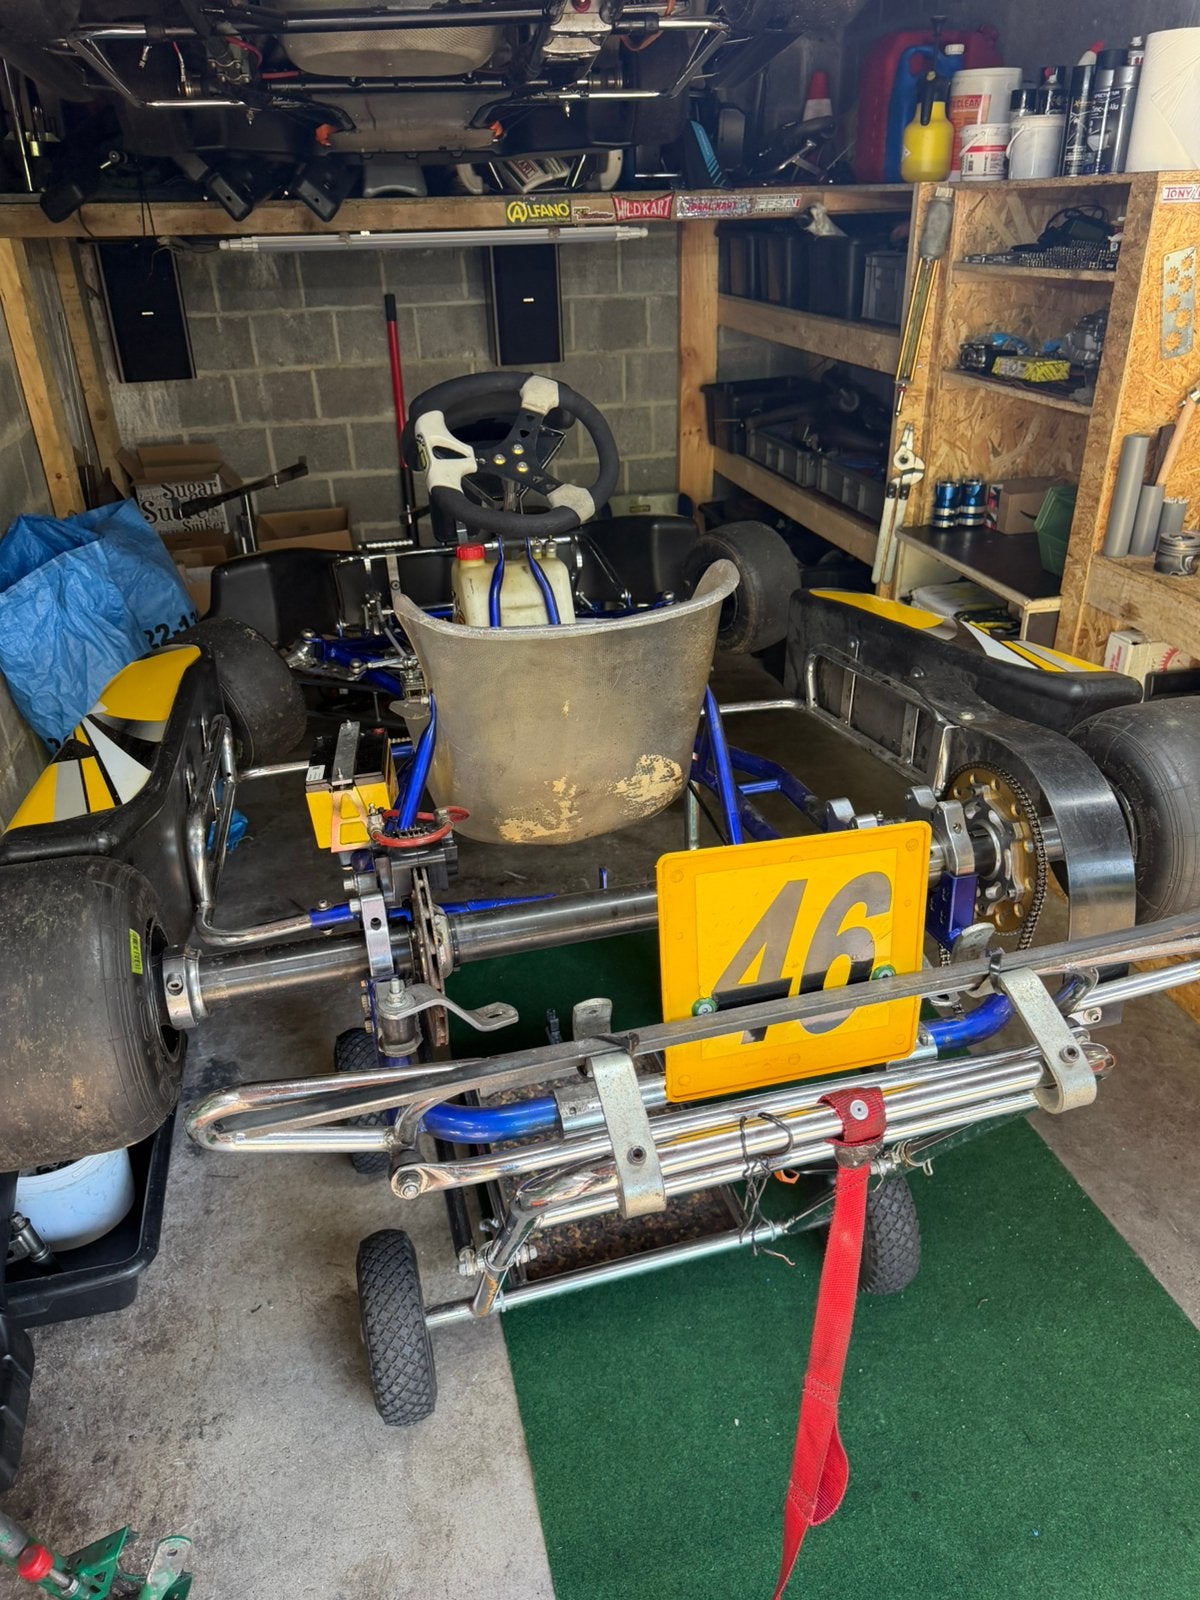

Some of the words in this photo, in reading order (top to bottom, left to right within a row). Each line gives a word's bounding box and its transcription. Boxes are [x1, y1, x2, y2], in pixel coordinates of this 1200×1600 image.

[1165, 187, 1192, 198] TONY
[507, 202, 570, 223] ALFANO
[161, 480, 218, 500] Sugar
[711, 871, 892, 1045] 46
